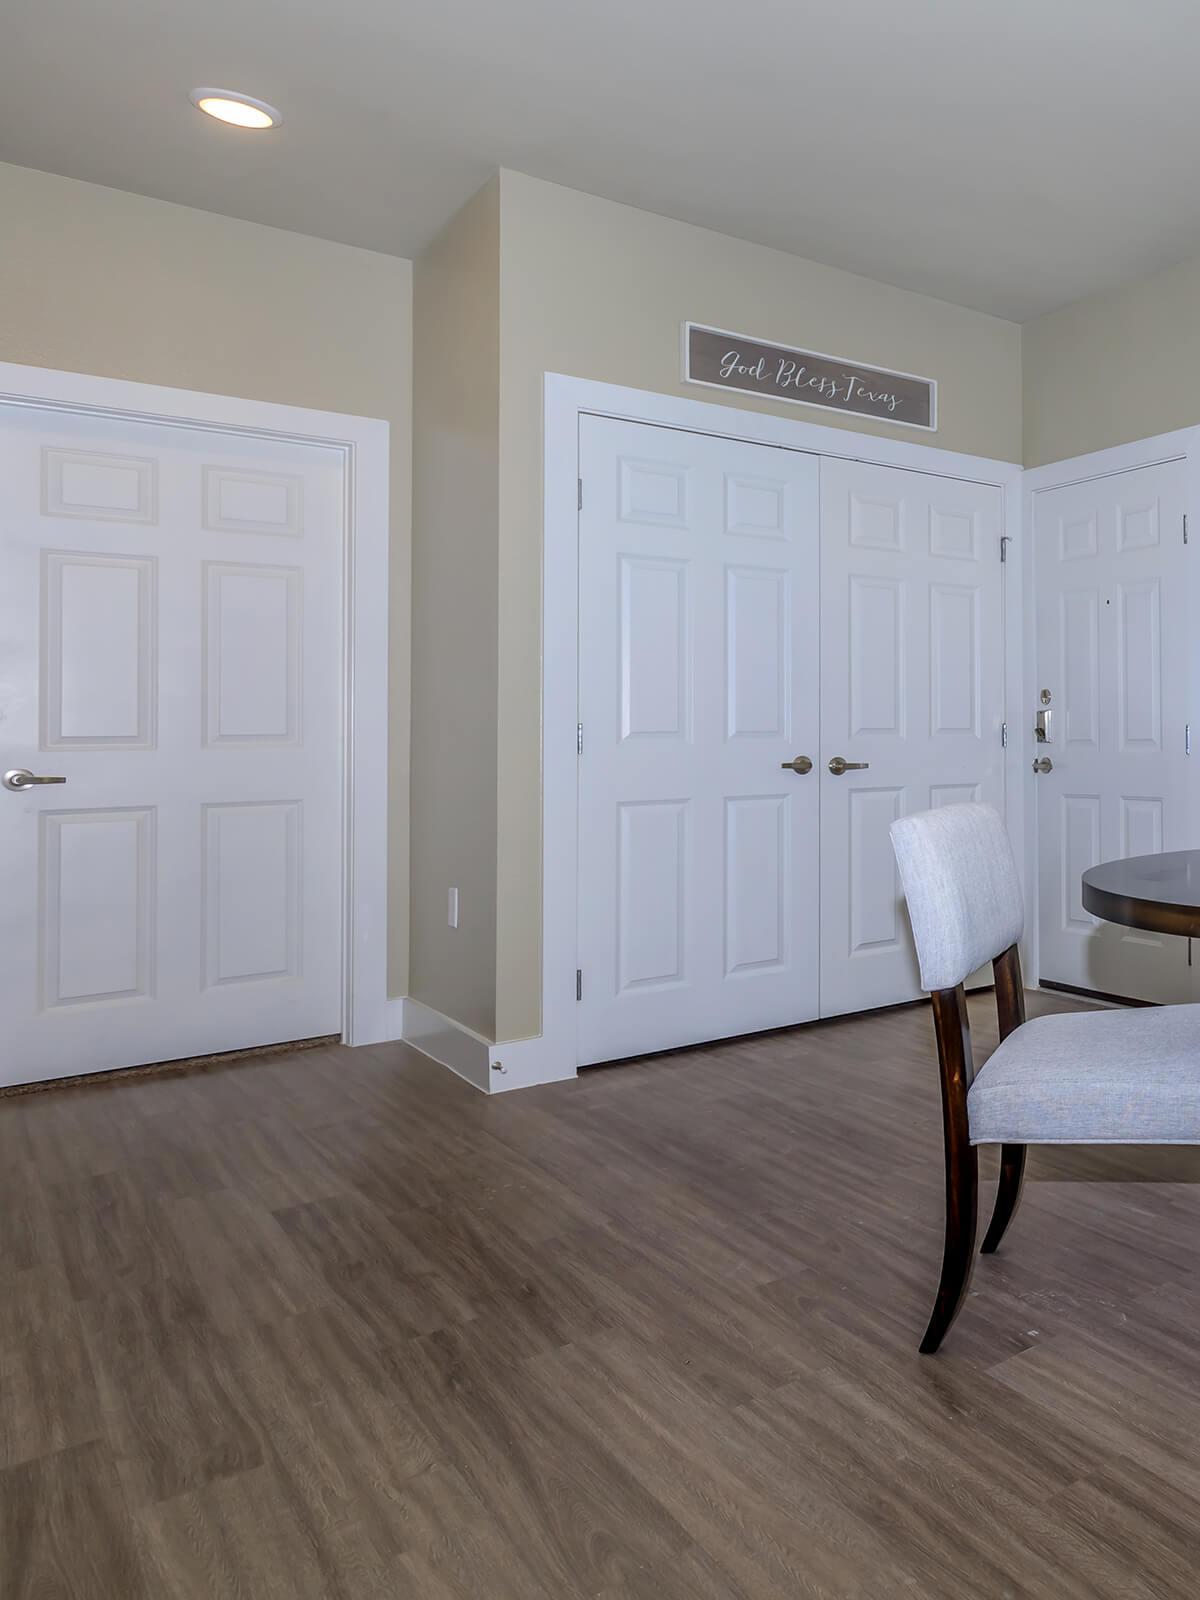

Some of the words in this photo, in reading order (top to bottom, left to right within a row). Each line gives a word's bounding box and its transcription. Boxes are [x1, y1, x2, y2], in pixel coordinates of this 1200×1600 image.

[719, 350, 771, 378] God
[775, 358, 843, 398] Bless
[842, 373, 903, 411] Texas
